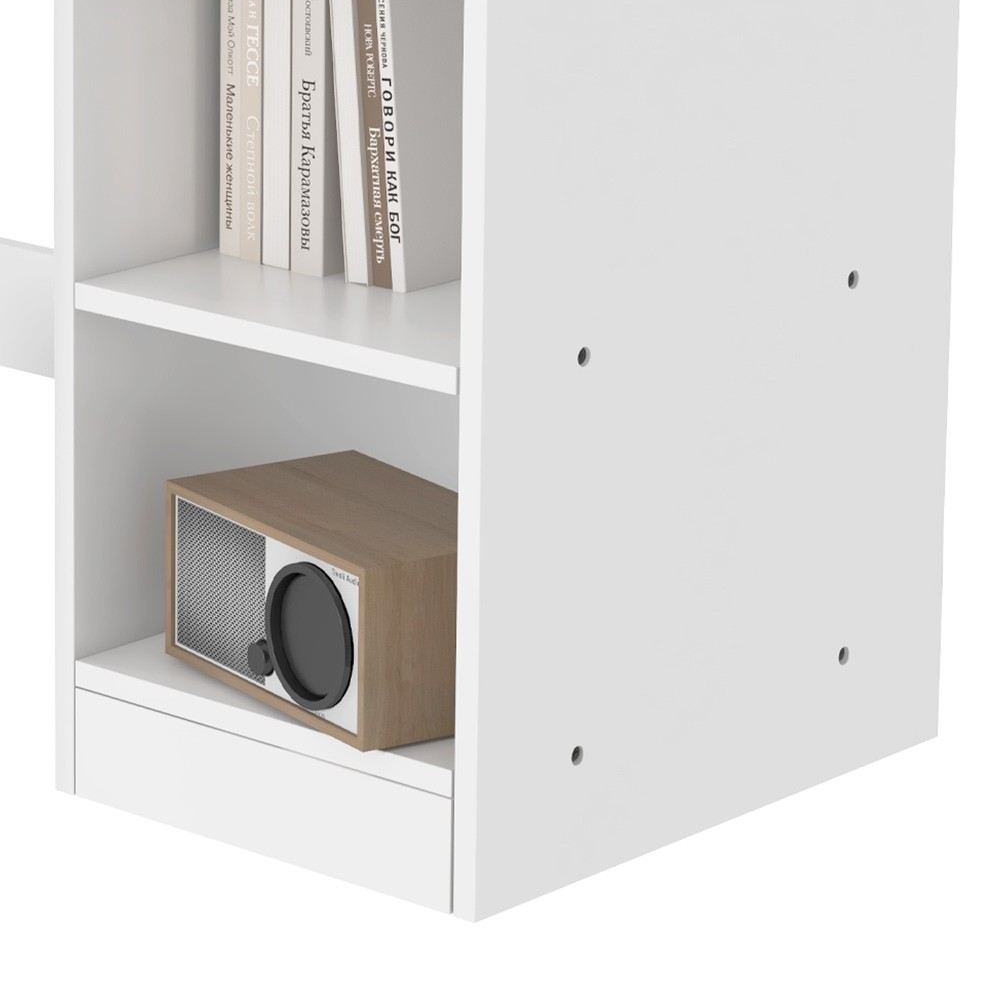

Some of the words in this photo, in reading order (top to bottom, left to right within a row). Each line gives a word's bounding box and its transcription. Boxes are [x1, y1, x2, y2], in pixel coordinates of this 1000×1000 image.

[226, 15, 236, 37] Мэй
[363, 23, 374, 51] НОРА
[380, 31, 388, 69] ЧЕРНОВА
[226, 39, 236, 75] Олкотт
[246, 23, 259, 87] ГЕССЕ
[365, 52, 376, 98] РОБЕРТС
[225, 83, 236, 161] Маленькие
[299, 79, 316, 140] Братья
[381, 77, 396, 162] ГОВОРИ
[246, 115, 260, 195] Степной
[367, 126, 382, 208] Бархатная
[224, 163, 234, 230] женщины
[297, 144, 316, 251] Карамазовы
[386, 170, 399, 203] КАК
[373, 211, 386, 264] смерть
[389, 211, 401, 244] БОГ
